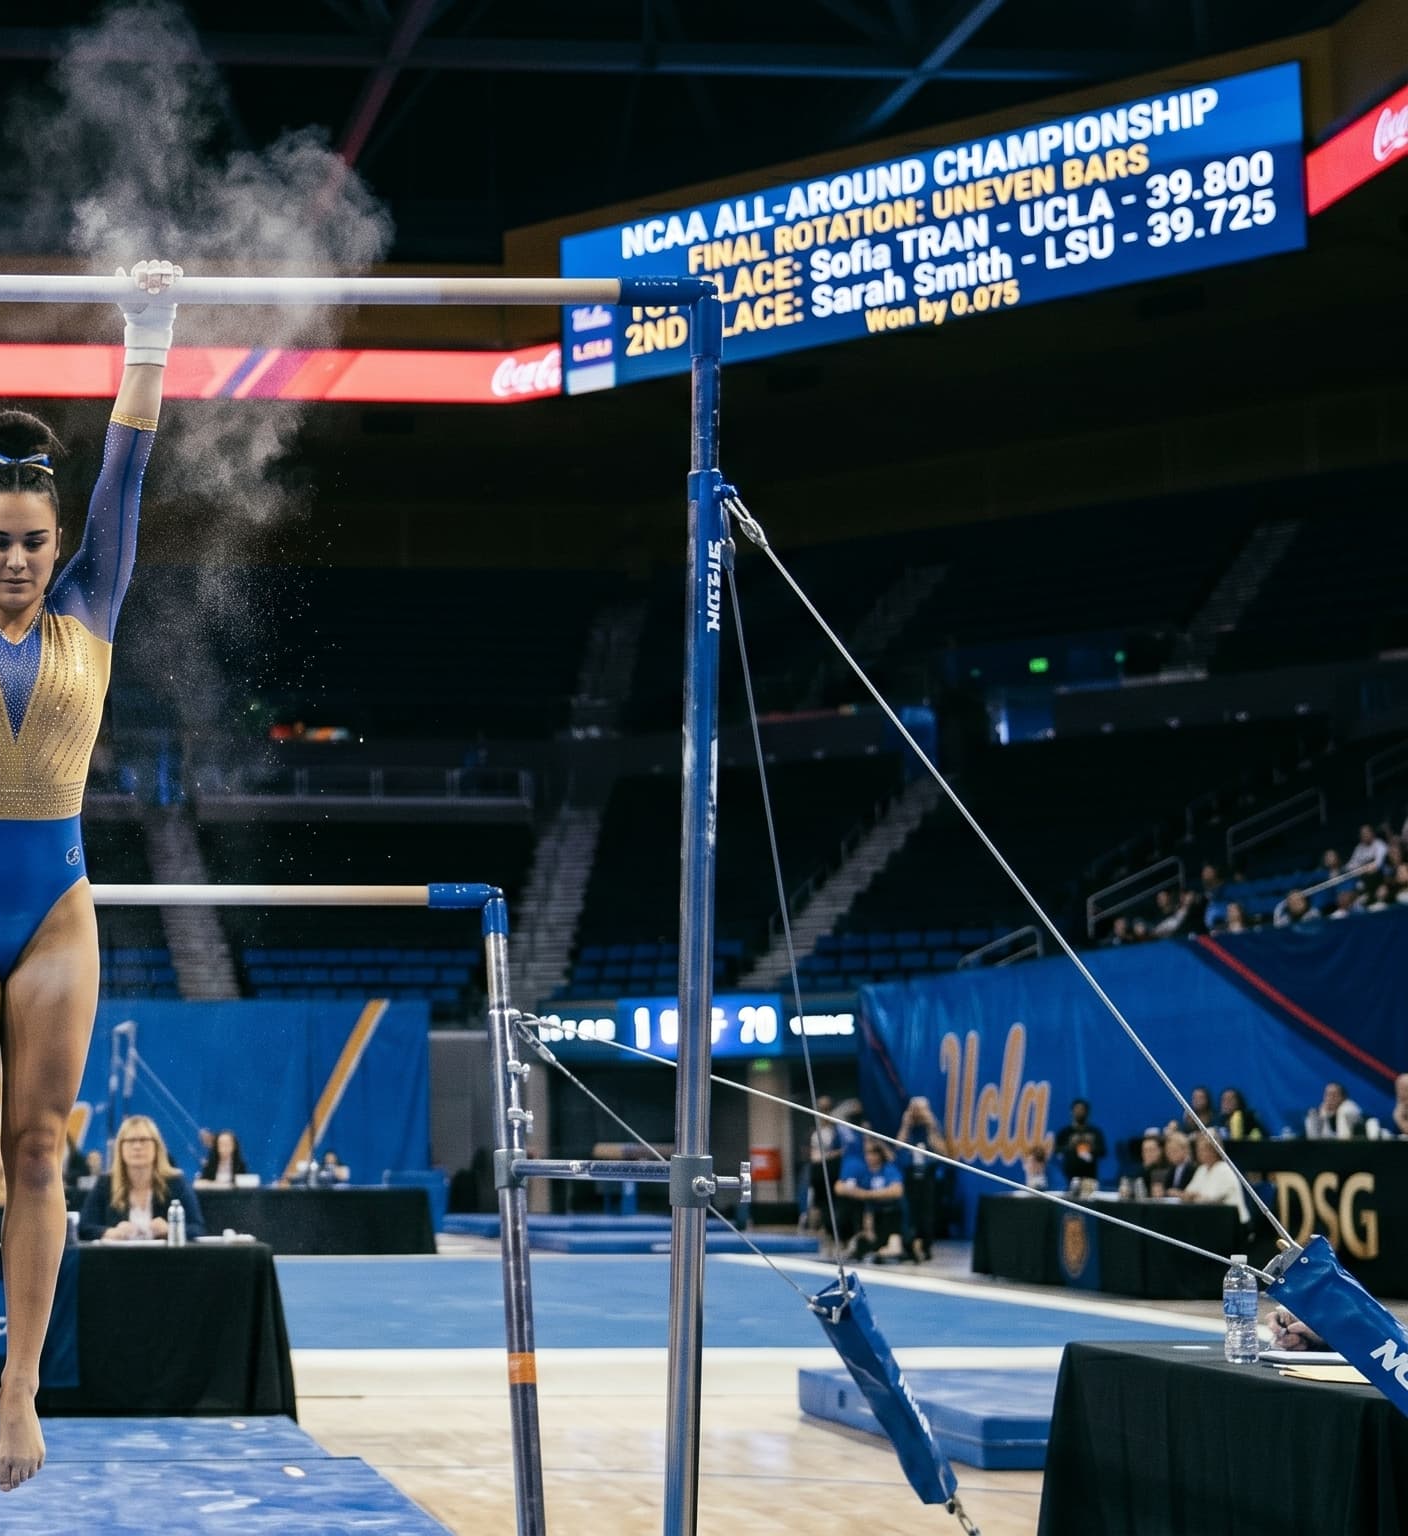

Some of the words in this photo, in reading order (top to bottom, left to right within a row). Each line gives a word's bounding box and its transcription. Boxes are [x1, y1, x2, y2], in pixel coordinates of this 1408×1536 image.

[622, 211, 708, 259] NCAA
[714, 159, 925, 238] ALL-AROUND
[933, 88, 1219, 186] CHAMPIONSHIP
[688, 232, 768, 274] FINAL
[774, 197, 925, 255] ROTATION:
[932, 164, 1055, 220] UNEVEN
[1062, 143, 1149, 190] BARS
[700, 256, 803, 303] LACE:
[810, 238, 892, 283] Sofia
[896, 213, 989, 264] TRAN
[1019, 187, 1115, 237] UCLA
[1146, 150, 1274, 209] 39.800
[624, 315, 688, 357] 2ND
[811, 269, 906, 318] Sarah
[913, 246, 1013, 297] Smith
[1044, 222, 1115, 270] LSU
[1147, 188, 1277, 247] 39.725
[864, 305, 916, 333] Won
[918, 297, 948, 325] by
[951, 279, 1020, 316] 0.075
